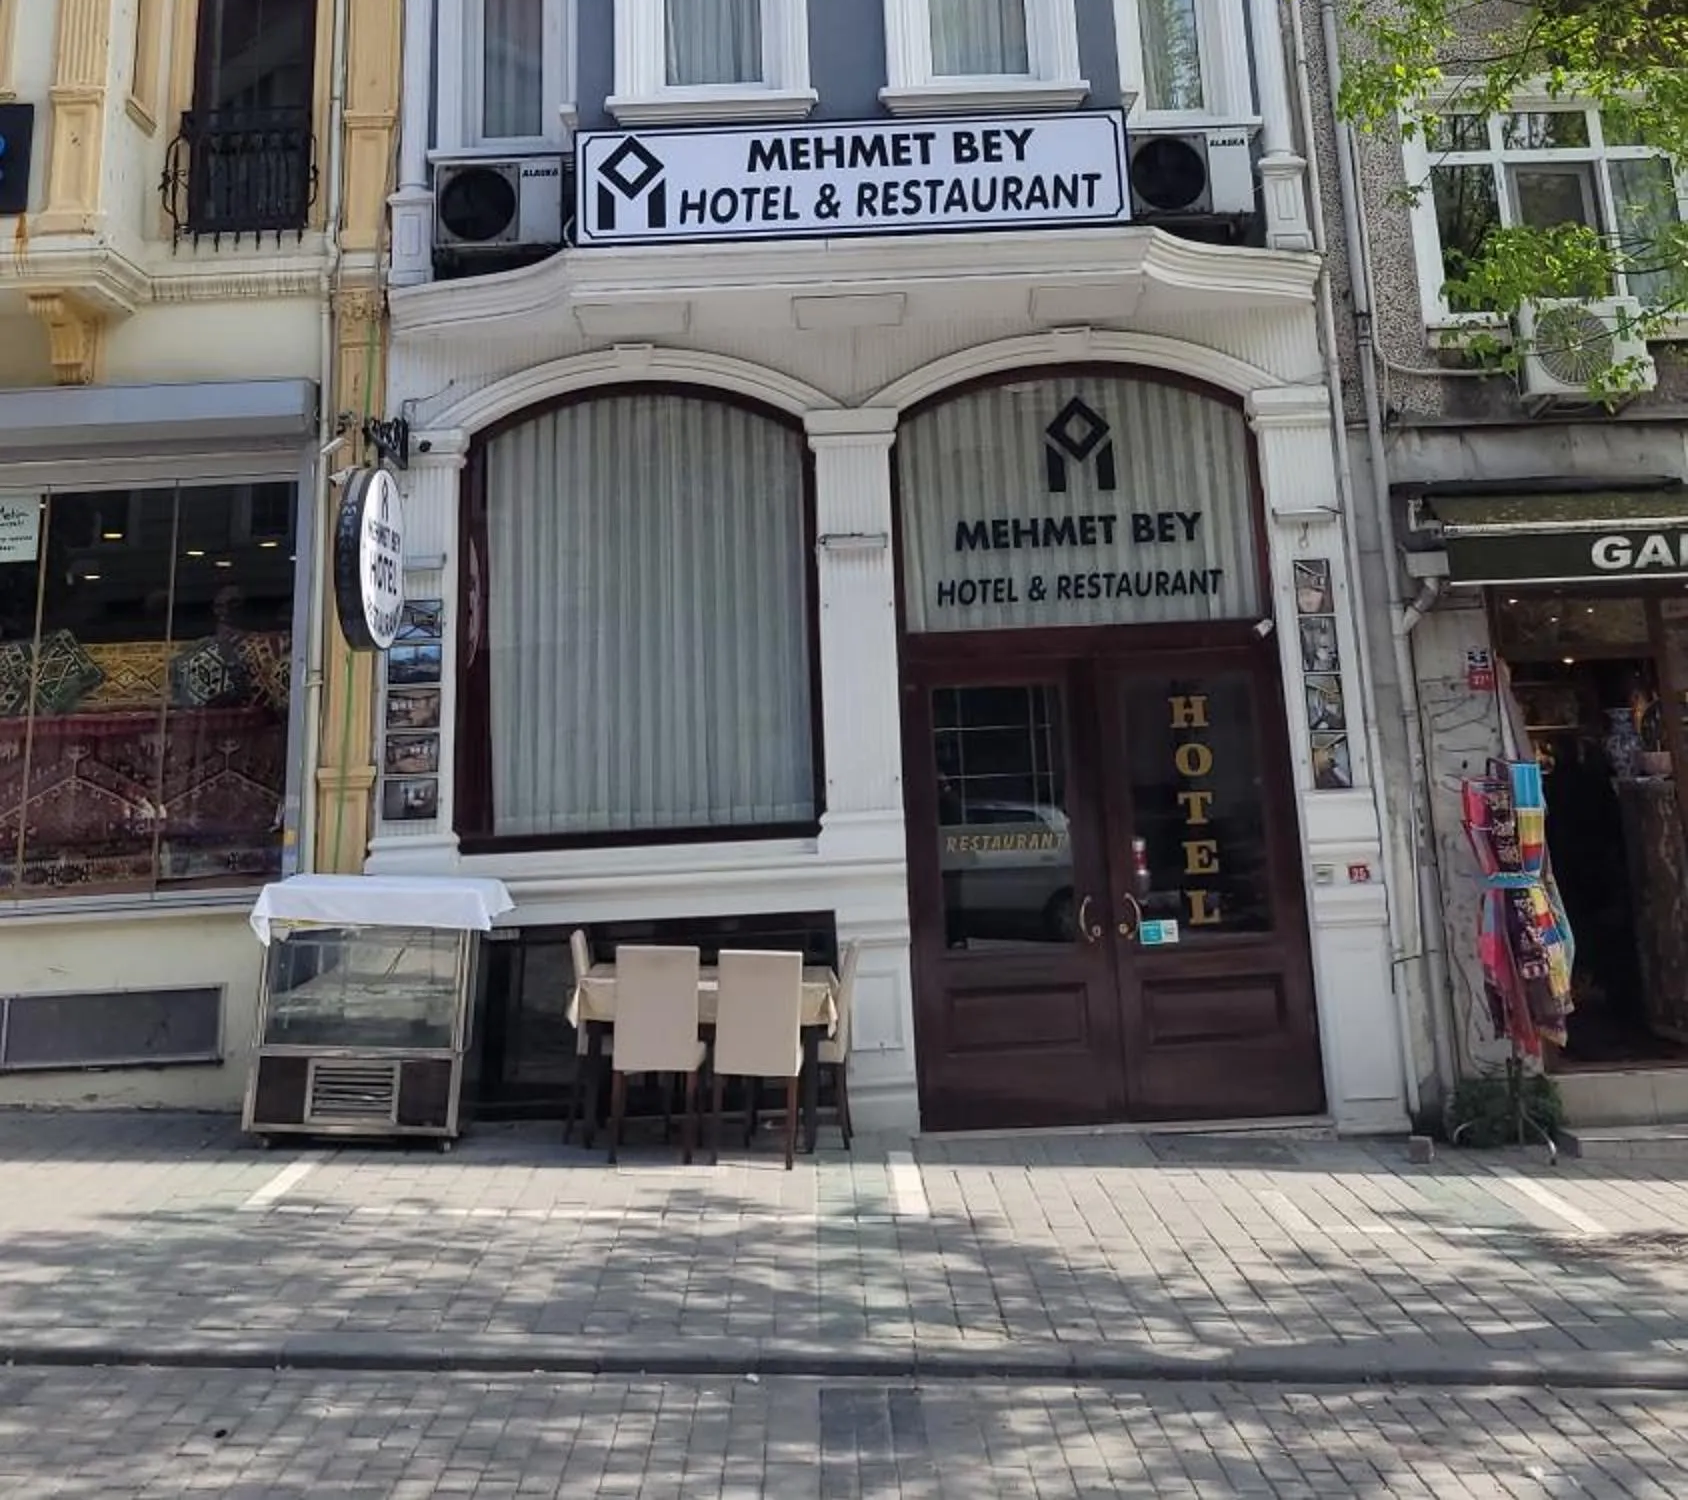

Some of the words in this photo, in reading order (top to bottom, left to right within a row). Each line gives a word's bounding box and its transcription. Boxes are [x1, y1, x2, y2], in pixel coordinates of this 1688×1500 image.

[747, 132, 936, 173] MEHMET
[953, 128, 1034, 163] BEY
[679, 186, 800, 225] HOTEL
[813, 184, 841, 220] &
[857, 173, 1102, 217] RESTAURANT
[955, 514, 1117, 551] MEHMET
[1131, 511, 1202, 543] BEY
[1591, 533, 1688, 570] GA
[370, 553, 397, 596] HOTEL
[937, 577, 1018, 607] HOTEL
[1028, 575, 1047, 601] &
[1057, 568, 1223, 601] RESTAURANT
[1168, 695, 1222, 925] HOTEL
[946, 833, 1066, 853] RESTAURANT
